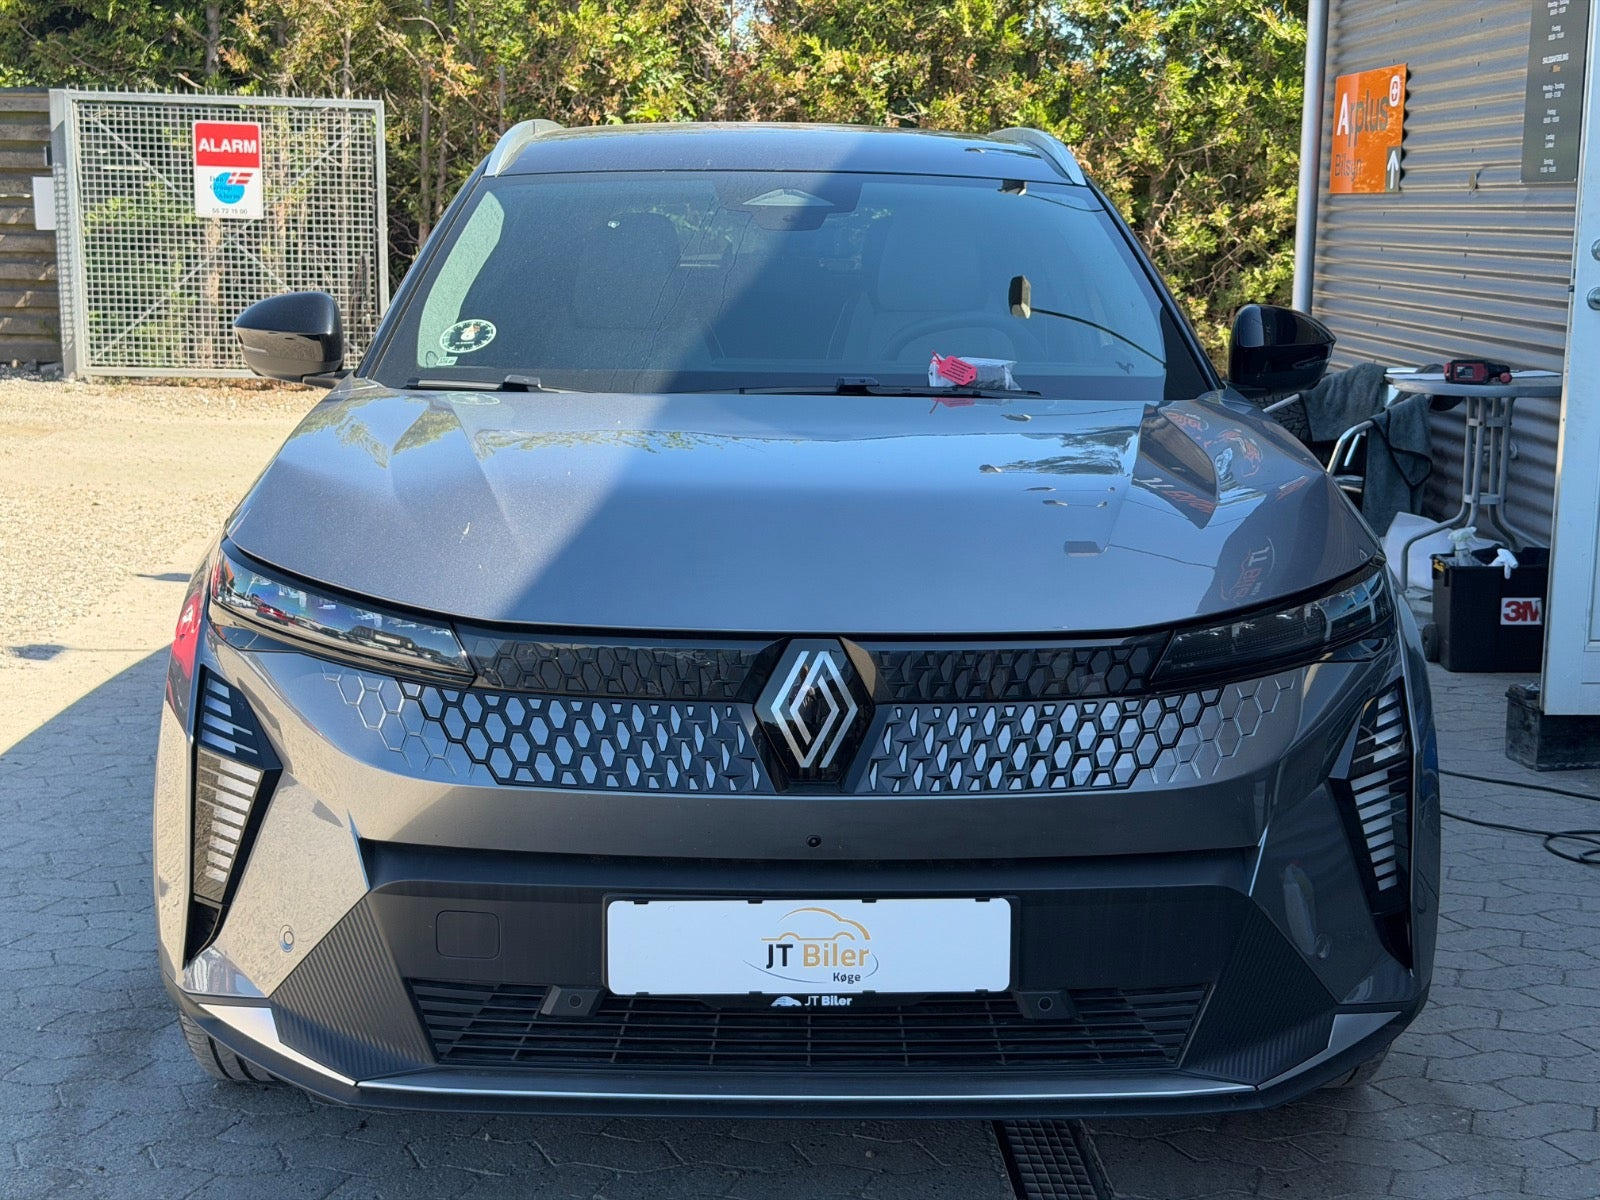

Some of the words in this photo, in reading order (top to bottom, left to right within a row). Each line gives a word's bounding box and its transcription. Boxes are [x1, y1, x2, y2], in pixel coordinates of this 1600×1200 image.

[198, 138, 257, 154] ALARM
[1503, 601, 1541, 622] 3M
[766, 944, 794, 969] JT
[803, 943, 870, 967] Biler
[833, 972, 861, 984] Køge
[804, 995, 819, 1006] JT
[821, 995, 853, 1006] Biler
